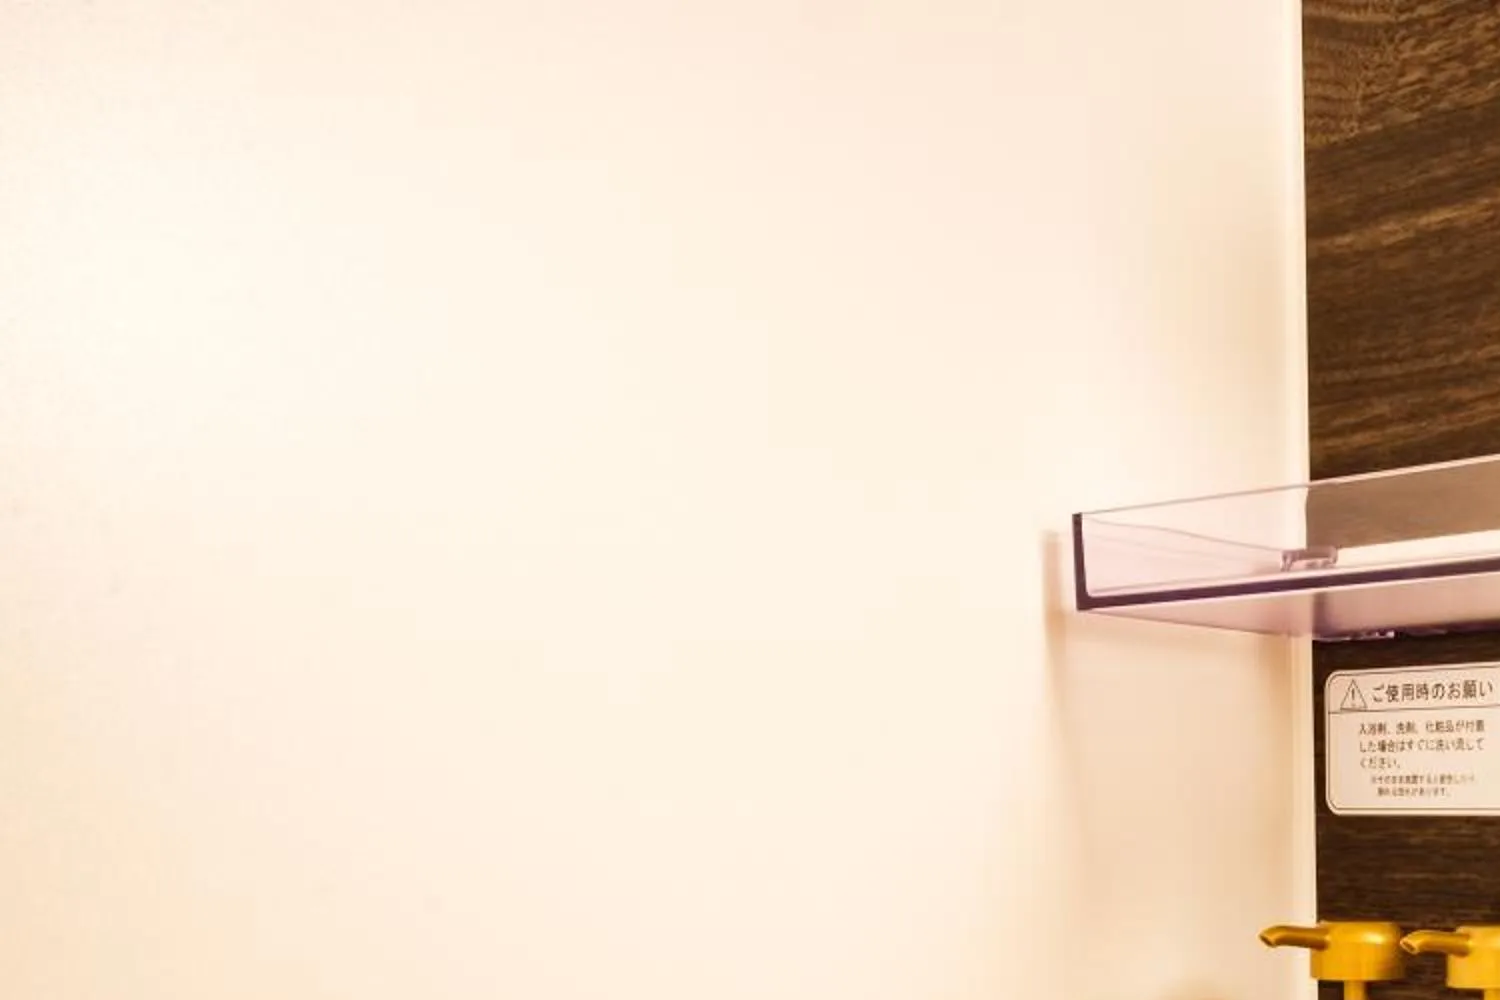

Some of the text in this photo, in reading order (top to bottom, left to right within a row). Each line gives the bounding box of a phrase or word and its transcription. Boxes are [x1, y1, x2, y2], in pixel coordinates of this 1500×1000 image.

[1372, 680, 1493, 702] ご使用時のお願い
